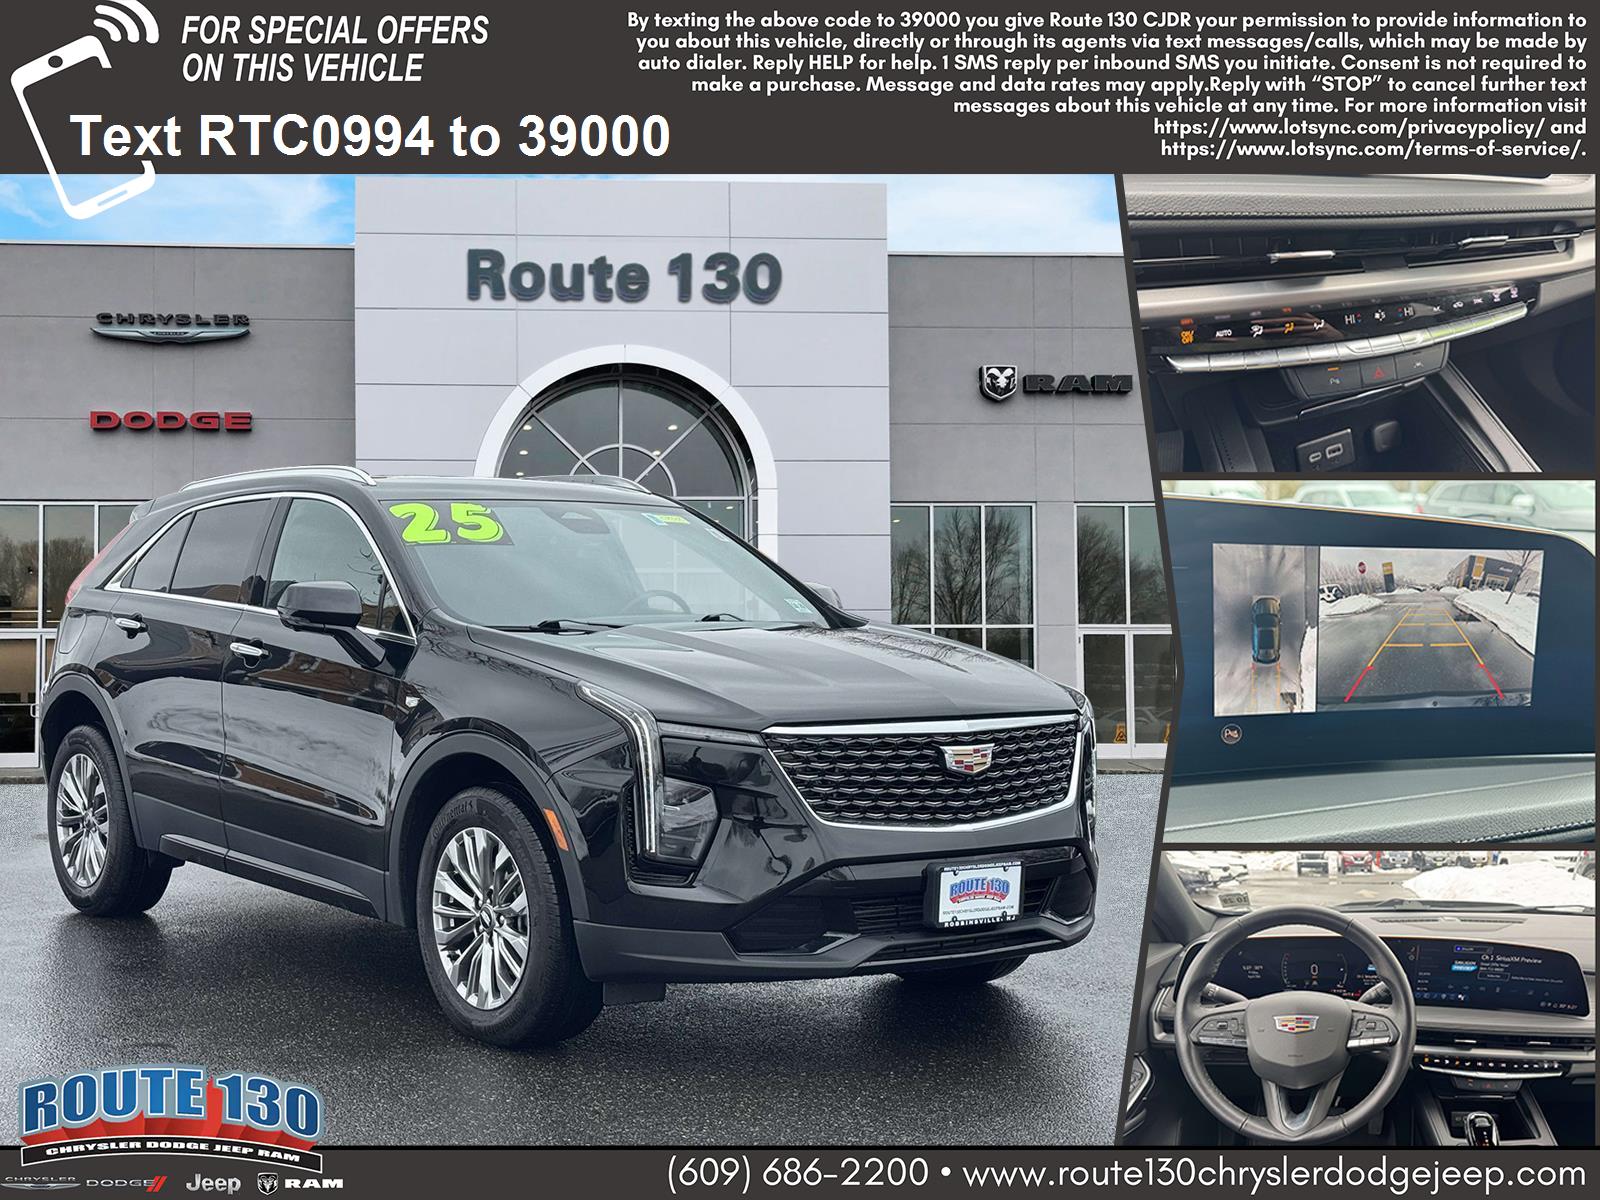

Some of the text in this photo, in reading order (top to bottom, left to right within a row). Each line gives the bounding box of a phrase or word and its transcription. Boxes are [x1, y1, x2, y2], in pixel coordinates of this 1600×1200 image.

[467, 249, 782, 305] Route 130
[96, 312, 250, 326] CHRYSLER
[1216, 329, 1232, 337] AUTO
[1023, 374, 1133, 394] RAM
[90, 411, 252, 432] DODGE
[389, 503, 505, 544] 25
[950, 878, 1010, 897] ROUTE 130
